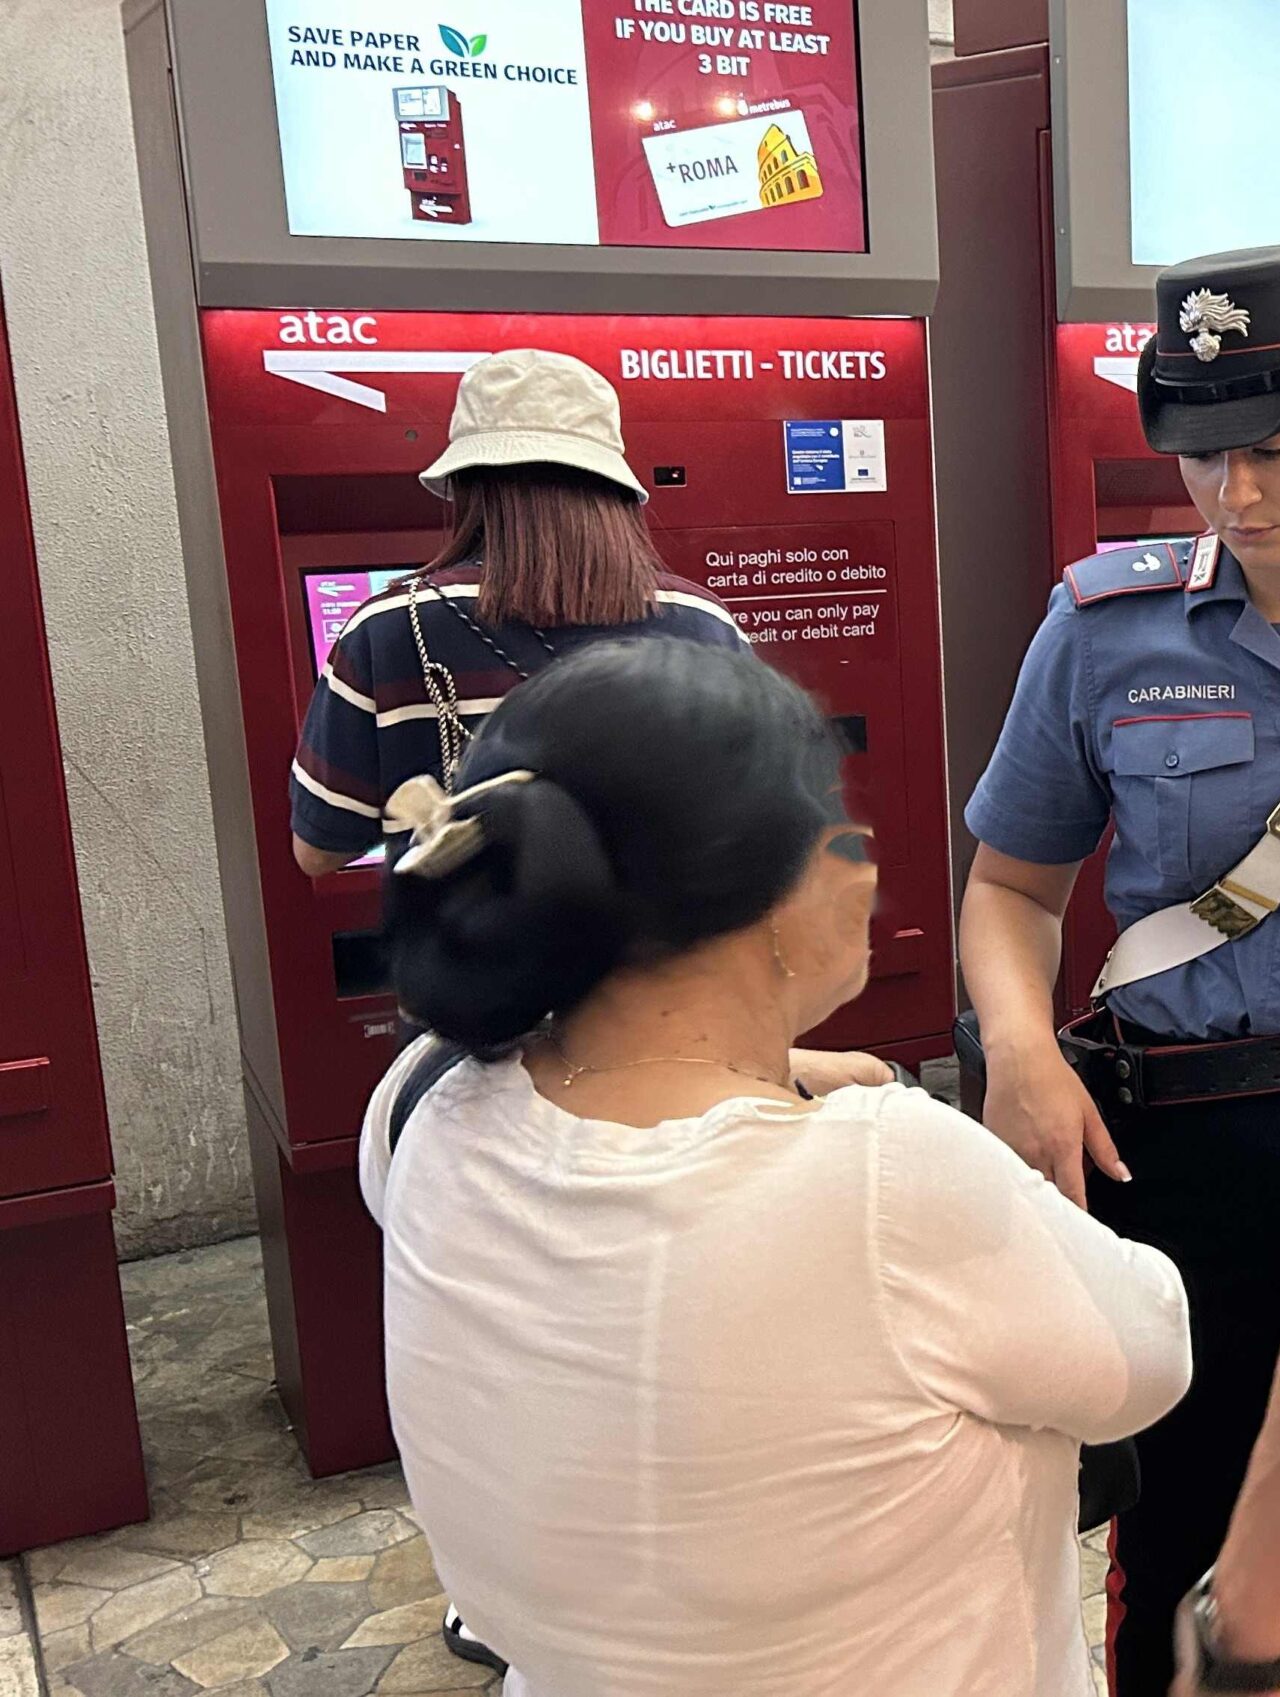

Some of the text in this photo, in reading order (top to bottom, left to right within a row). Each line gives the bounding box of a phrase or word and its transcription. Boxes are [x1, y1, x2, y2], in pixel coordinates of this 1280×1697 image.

[634, 0, 812, 27] THE CARD IS FREE
[288, 25, 420, 52] SAVE PAPER
[615, 18, 830, 55] IF YOU BUY AT LEAST
[290, 49, 578, 85] AND MAKE A GREEN CHOICE
[698, 54, 751, 76] 3 BIT
[653, 119, 677, 131] atac
[279, 310, 378, 345] atac
[1105, 323, 1154, 352] ata
[620, 349, 754, 380] BIGLIETTI
[777, 350, 887, 380] TICKETS
[706, 548, 849, 568] Qui paghi solo con
[707, 564, 887, 588] carta di credito o debito
[752, 611, 781, 626] you
[785, 607, 813, 621] can
[817, 604, 849, 622] only
[852, 604, 880, 618] pay
[782, 629, 798, 641] or
[801, 624, 839, 640] debit
[843, 622, 875, 637] card
[1127, 684, 1236, 704] CARABINIERI
